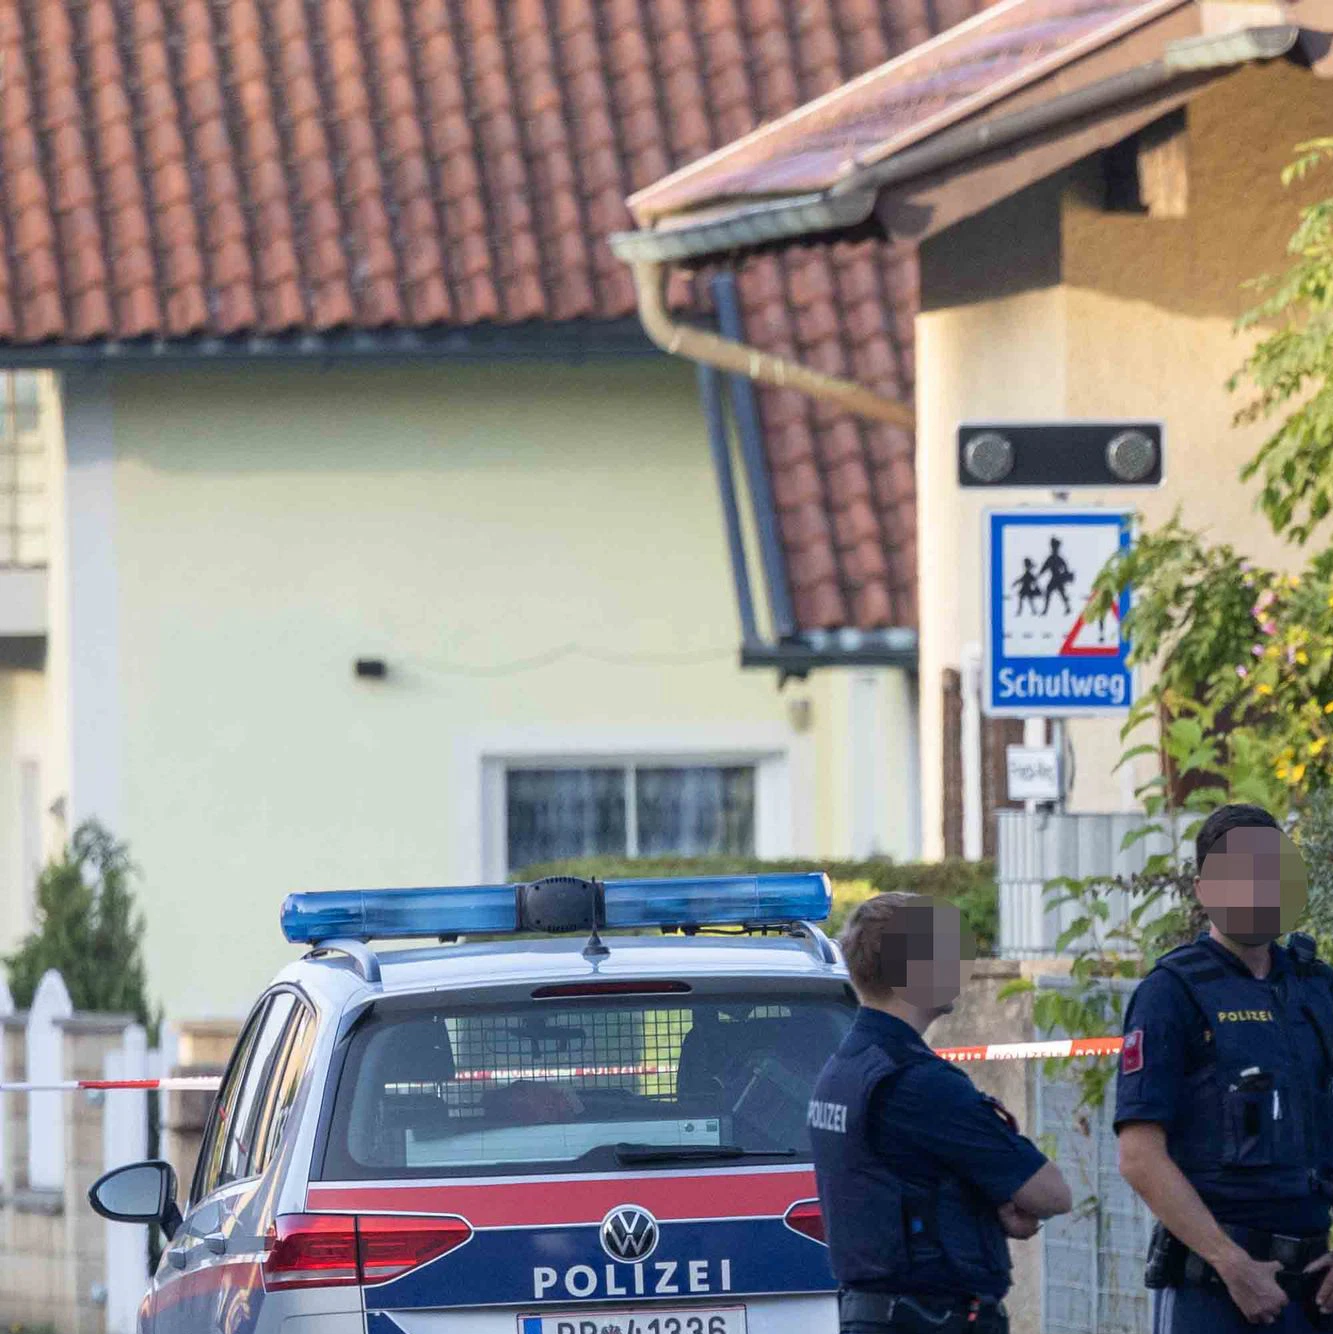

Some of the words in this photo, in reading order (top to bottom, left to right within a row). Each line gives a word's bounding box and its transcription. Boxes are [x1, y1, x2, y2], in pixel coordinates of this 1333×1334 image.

[998, 667, 1125, 704] Schulweg
[1217, 1010, 1273, 1023] POLIZEI
[807, 1100, 848, 1133] POLIZEI
[533, 1259, 731, 1299] POLIZEI
